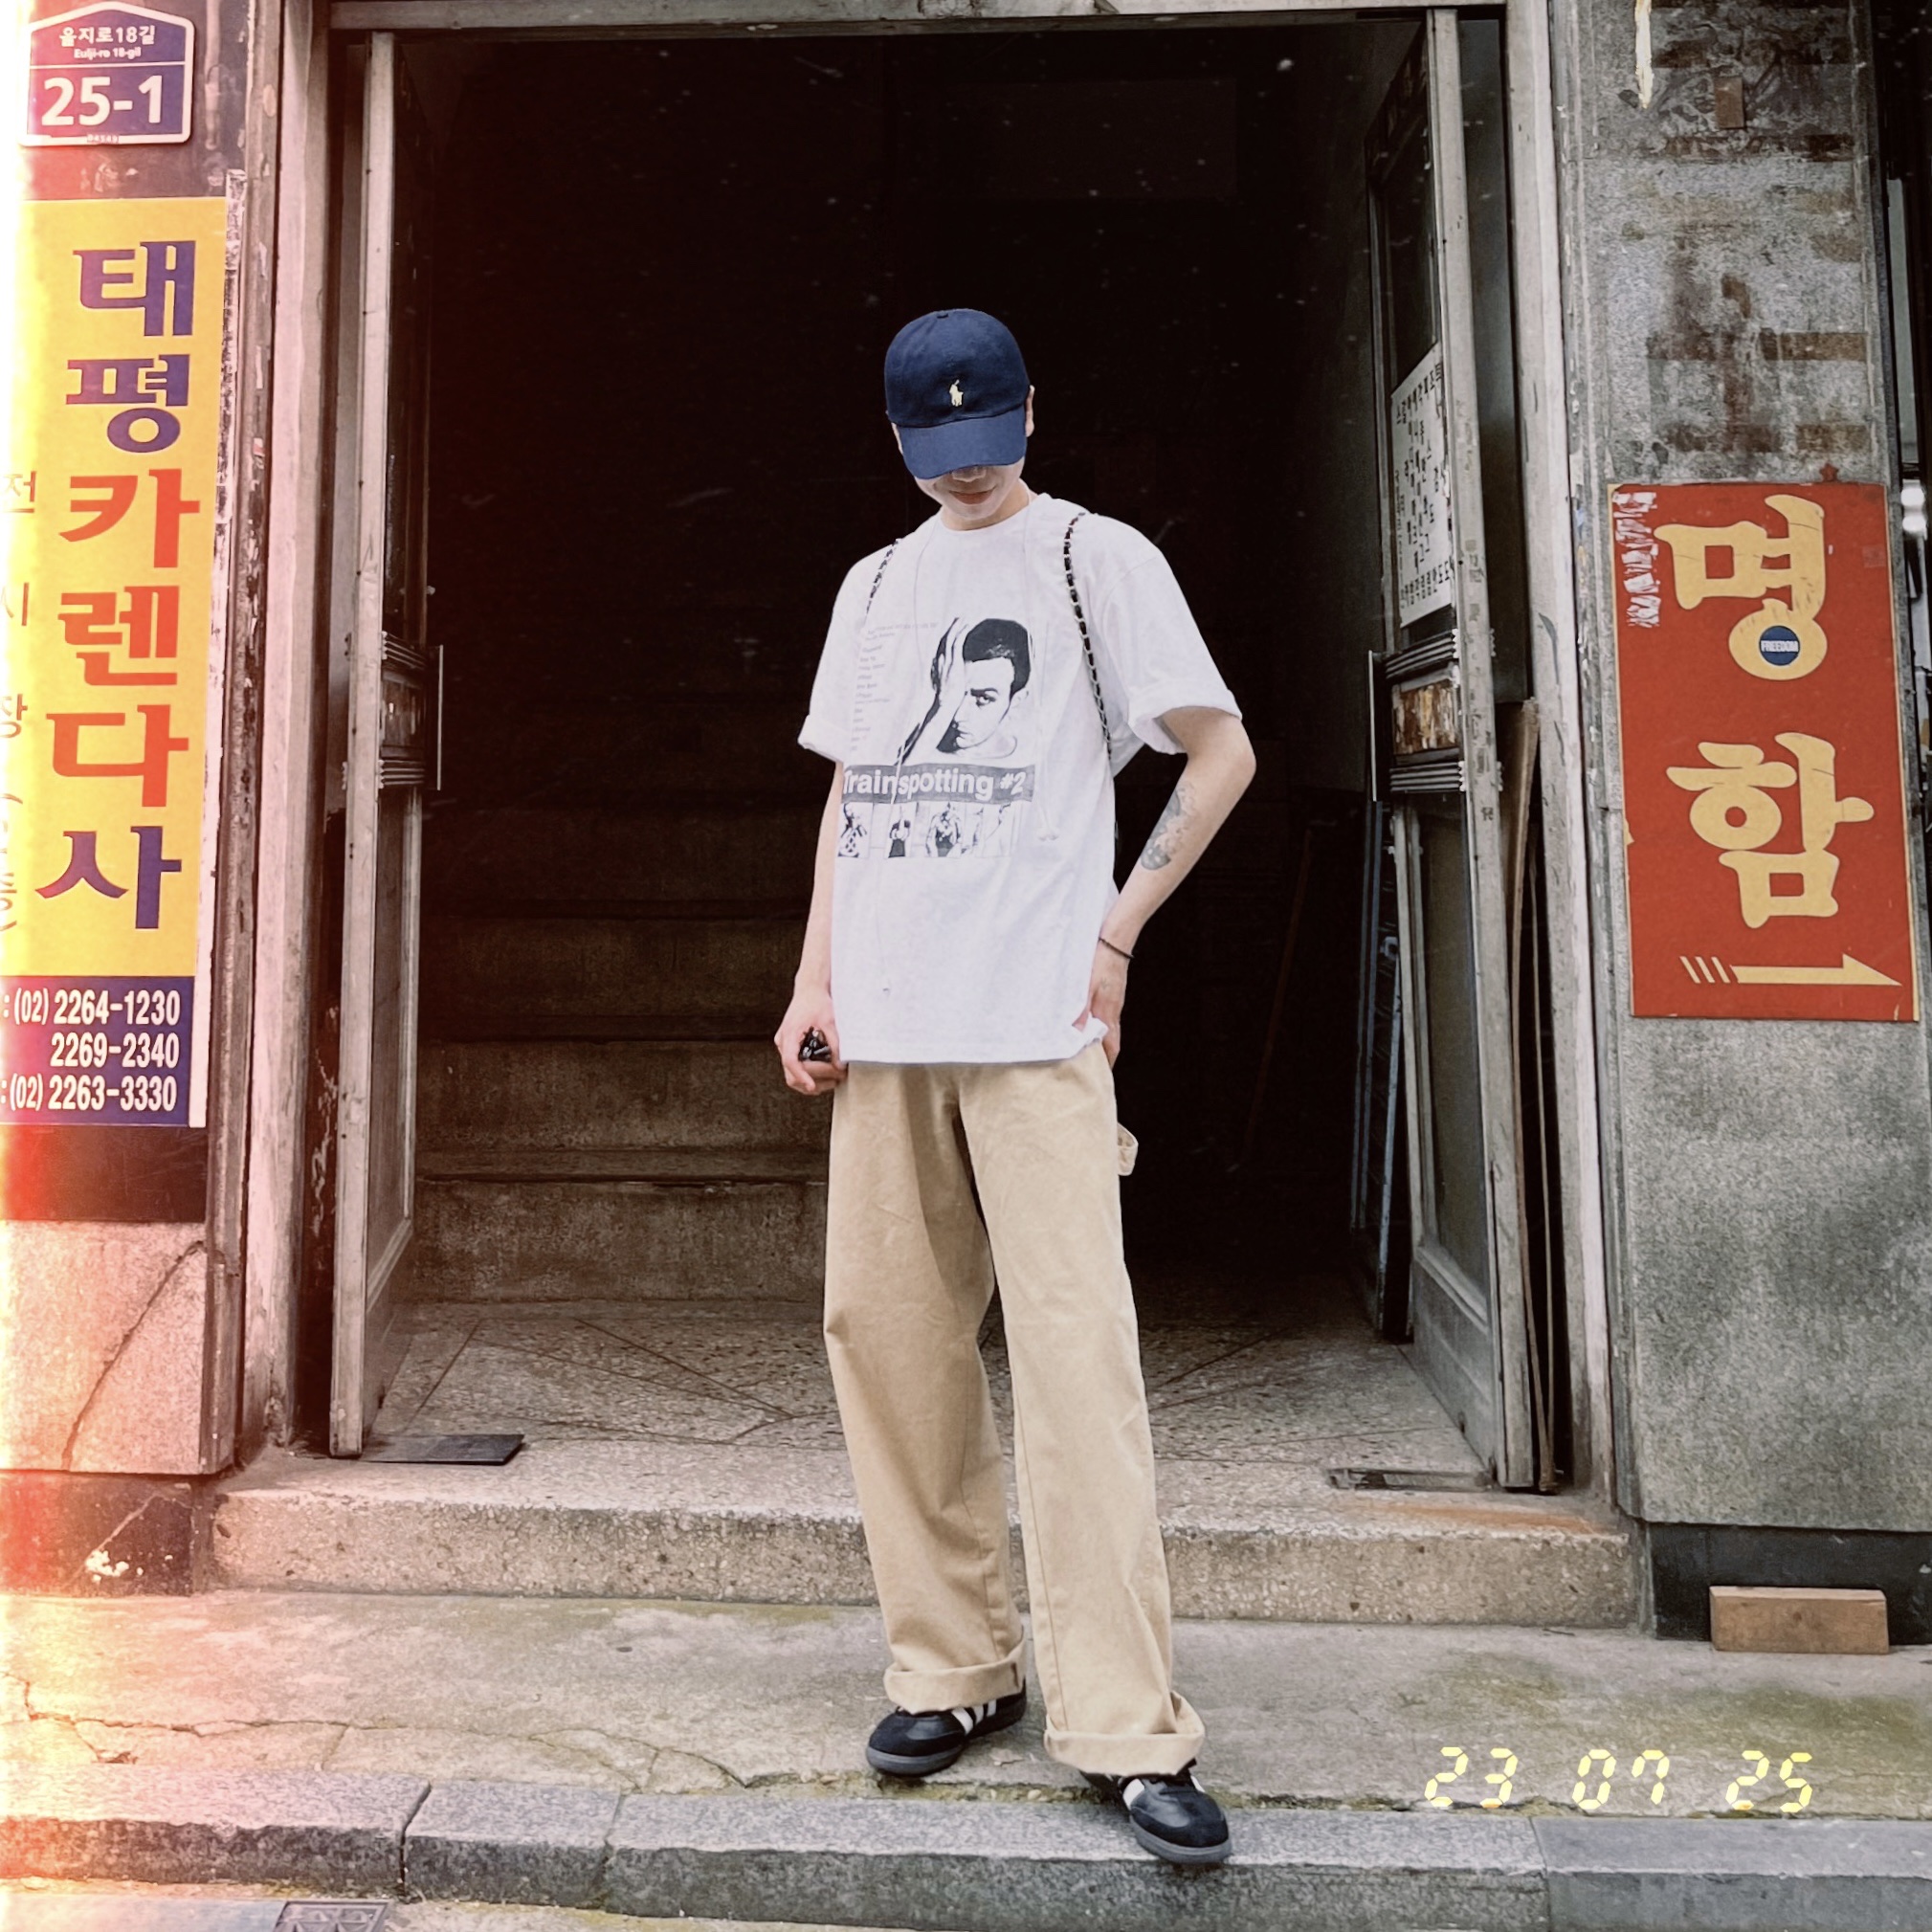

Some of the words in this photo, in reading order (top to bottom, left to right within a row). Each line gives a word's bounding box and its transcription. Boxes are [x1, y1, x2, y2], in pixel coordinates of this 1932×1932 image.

[59, 25, 156, 47] 을지로18길
[41, 75, 163, 125] 25-1
[1654, 494, 1876, 928] 명함
[999, 771, 1027, 795] #2
[54, 989, 181, 1026] 2264-1230
[50, 1032, 180, 1068] 2269-2340
[48, 1075, 177, 1112] 2263-3330
